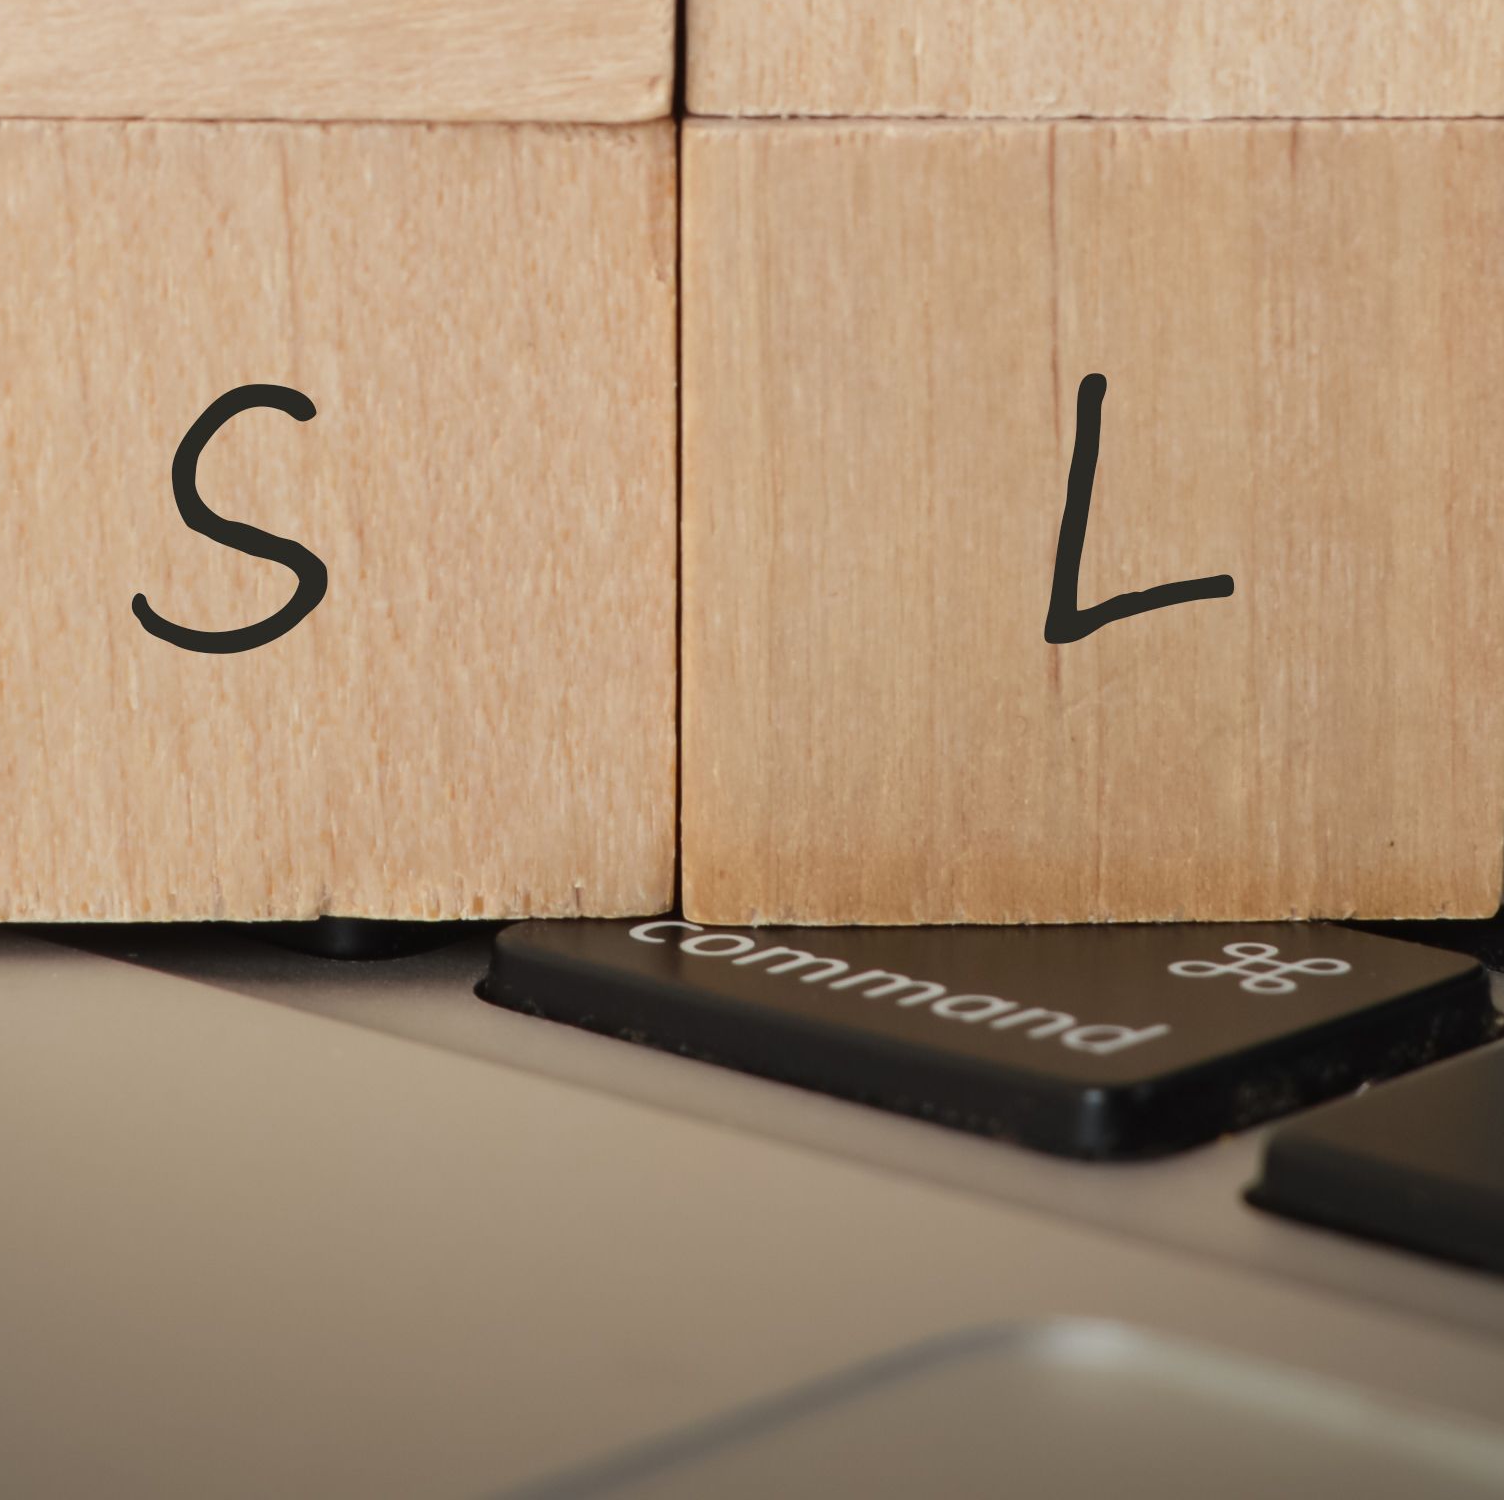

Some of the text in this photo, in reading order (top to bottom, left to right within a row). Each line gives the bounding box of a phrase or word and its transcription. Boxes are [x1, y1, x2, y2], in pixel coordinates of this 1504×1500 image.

[131, 383, 328, 655] S
[1043, 372, 1235, 645] L
[627, 920, 1172, 1057] command
